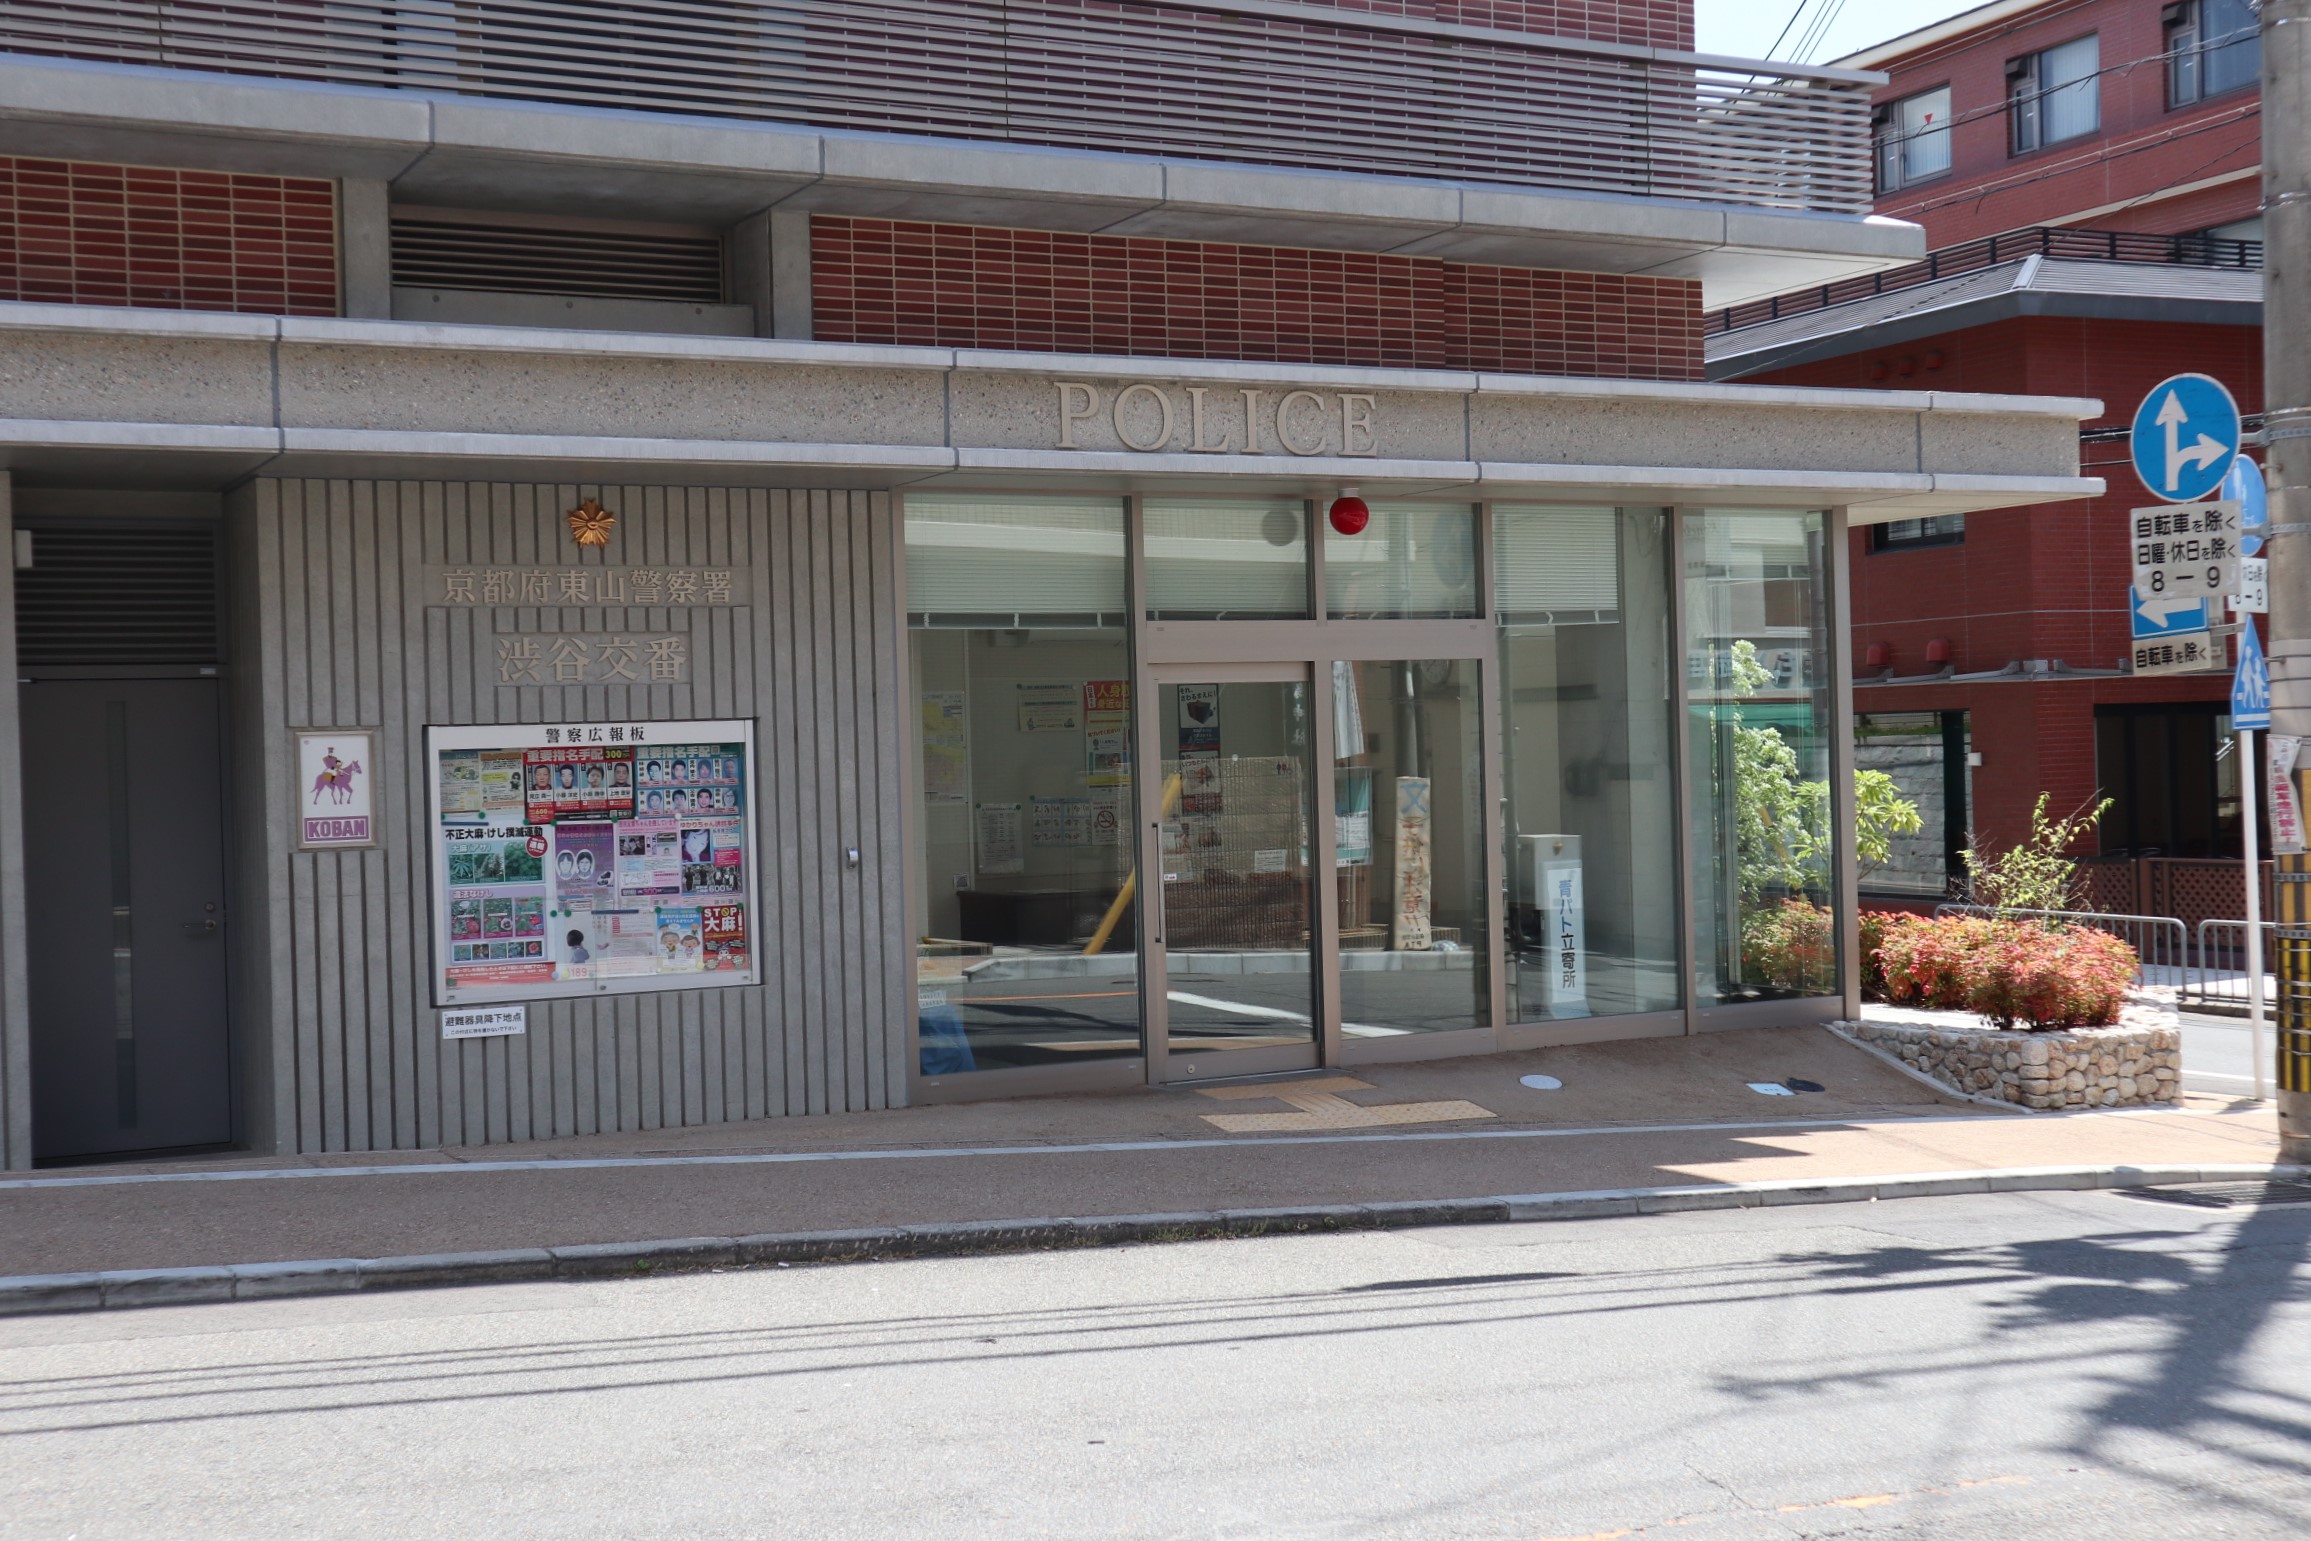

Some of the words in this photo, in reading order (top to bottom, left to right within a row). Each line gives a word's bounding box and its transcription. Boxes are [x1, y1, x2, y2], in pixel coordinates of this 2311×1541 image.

[1053, 381, 1378, 456] POLICE
[2137, 509, 2236, 538] 自転車を除く
[442, 569, 732, 604] 京都府東山警察署
[498, 636, 687, 682] 渋谷交番
[2136, 642, 2207, 668] 自転車を除く
[545, 726, 645, 744] 警察広報板
[527, 748, 604, 762] 重要指名手配
[637, 746, 712, 759] 重要指名手配
[308, 820, 365, 838] KOBAN
[1559, 880, 1576, 989] 青パト立寄所
[571, 967, 588, 977] 189
[445, 1012, 522, 1027] 避難器具降下地点
